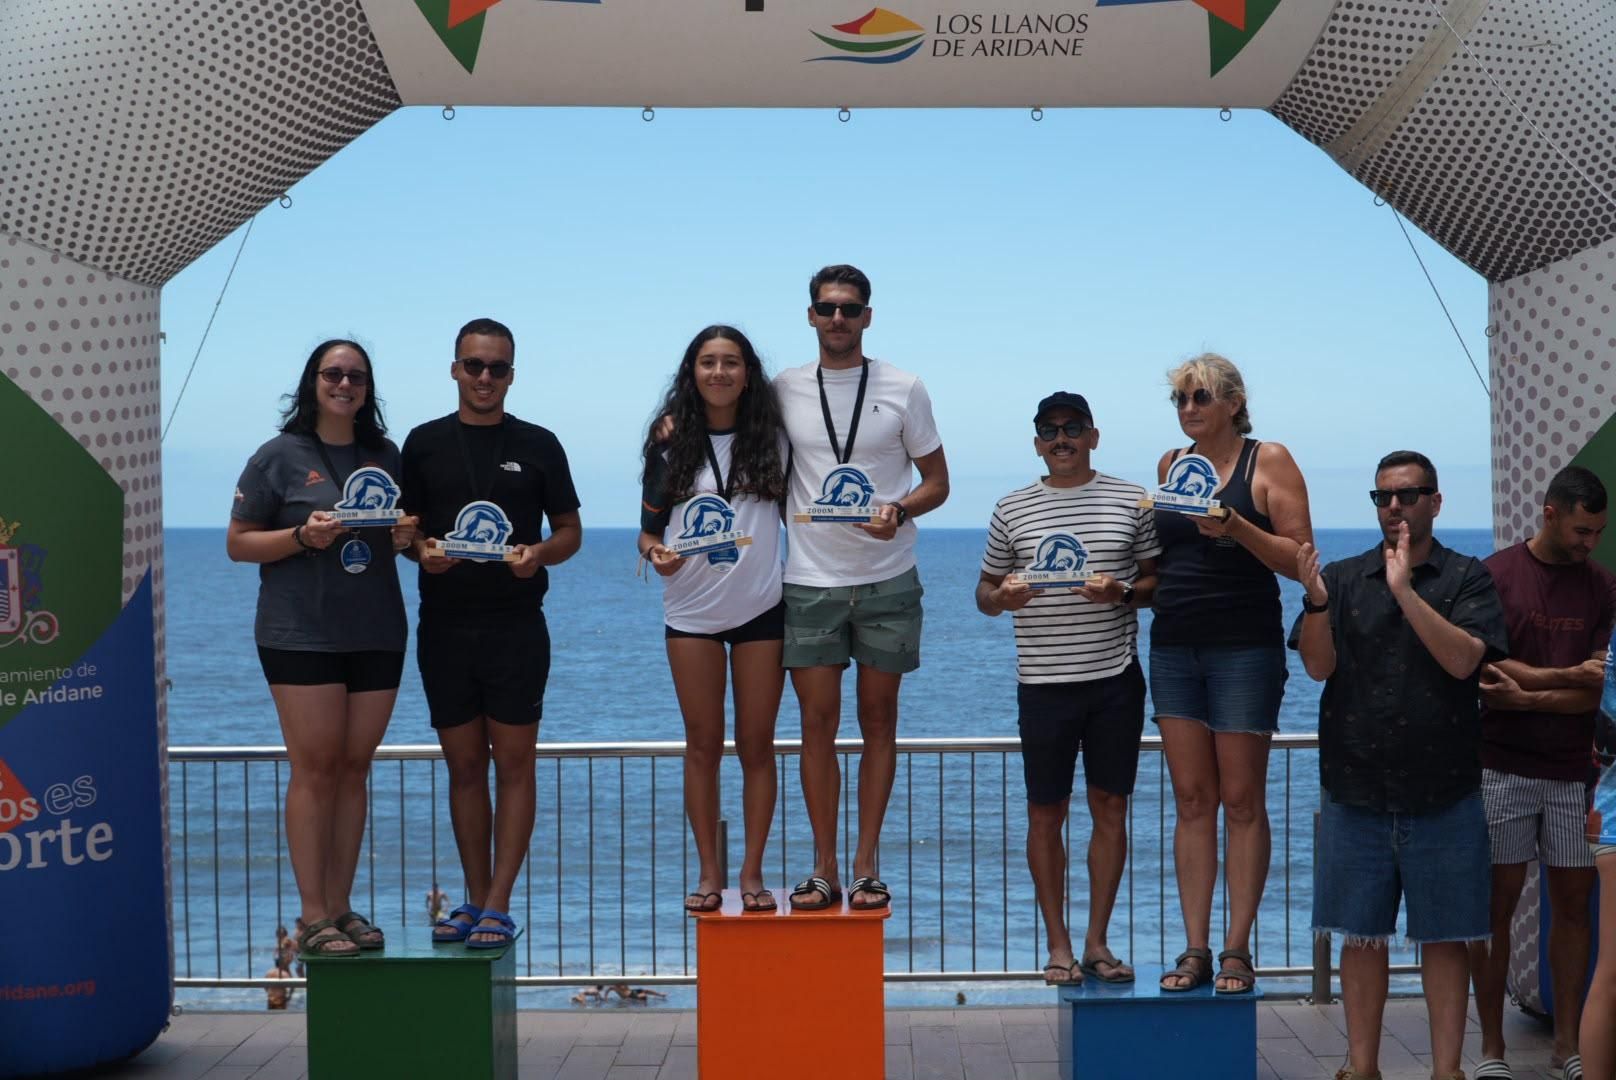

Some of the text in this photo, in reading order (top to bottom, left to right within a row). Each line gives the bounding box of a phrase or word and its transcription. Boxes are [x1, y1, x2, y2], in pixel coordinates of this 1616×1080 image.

[936, 13, 1089, 34] LOS LLANOS
[932, 38, 1085, 57] DE ARIDANE
[673, 539, 700, 551] 2000M
[76, 662, 97, 677] de
[22, 685, 103, 705] Aridane
[44, 775, 97, 815] es
